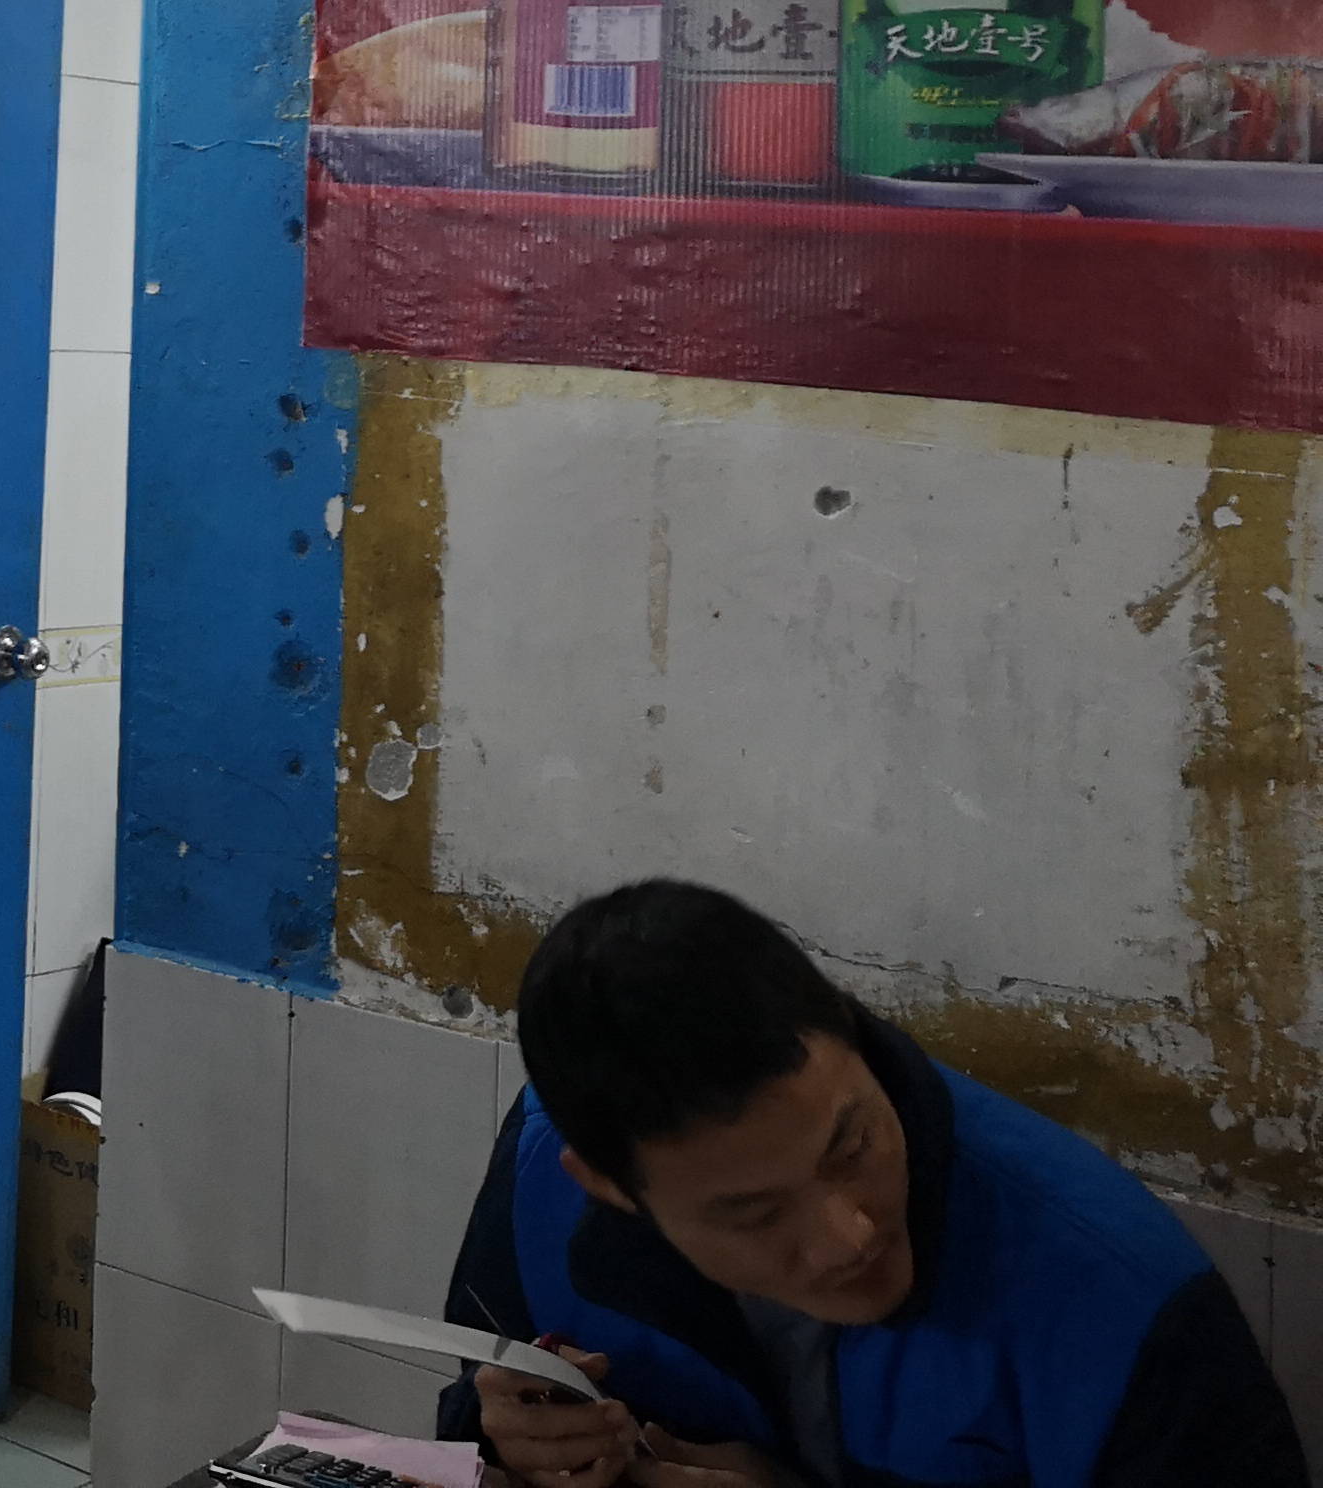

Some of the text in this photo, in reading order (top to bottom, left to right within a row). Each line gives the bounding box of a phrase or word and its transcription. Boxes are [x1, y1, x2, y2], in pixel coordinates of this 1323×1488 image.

[672, 2, 838, 61] 地壹
[885, 13, 1050, 62] 天地壹号
